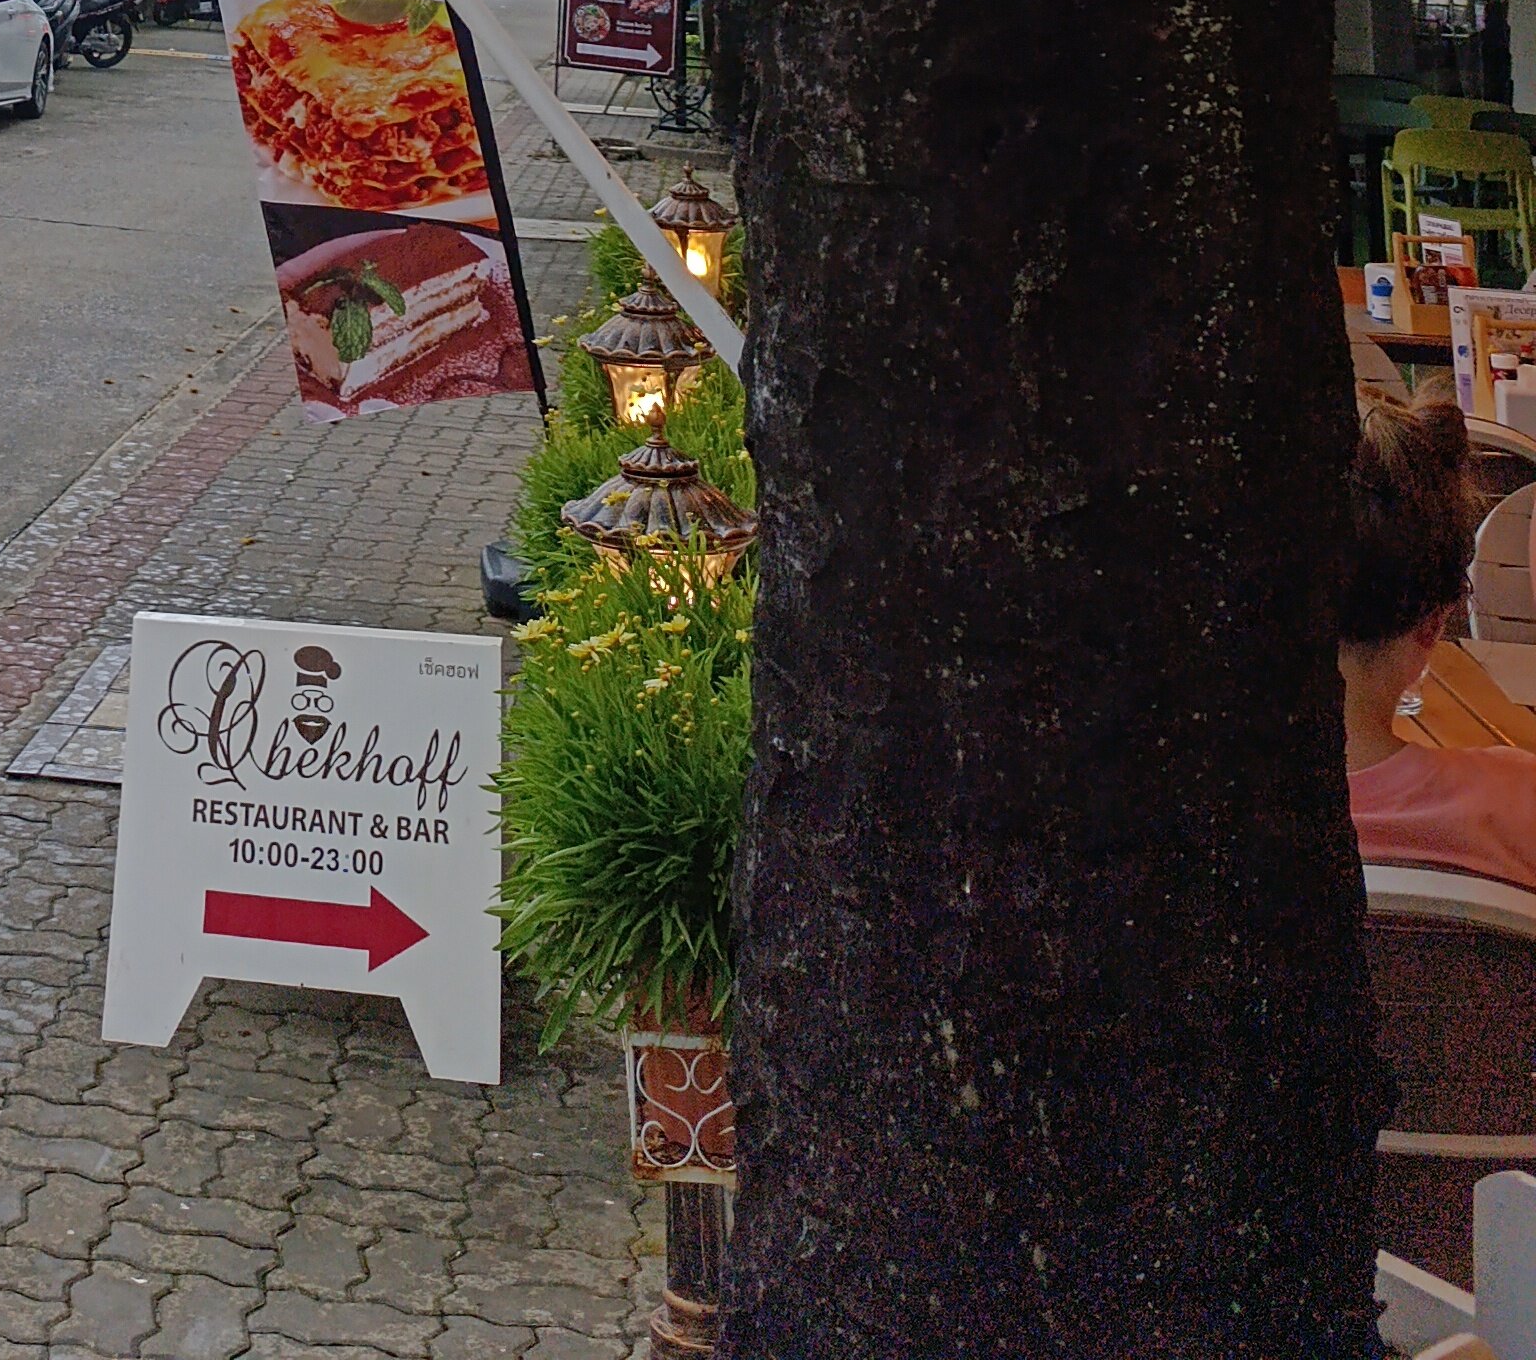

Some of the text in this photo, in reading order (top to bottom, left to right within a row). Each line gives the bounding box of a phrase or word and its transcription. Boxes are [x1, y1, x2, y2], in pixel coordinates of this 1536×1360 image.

[418, 656, 480, 679] เช็คฮอฟ
[157, 639, 468, 813] Chekhoff
[192, 798, 450, 845] RESTAURANT & BAR
